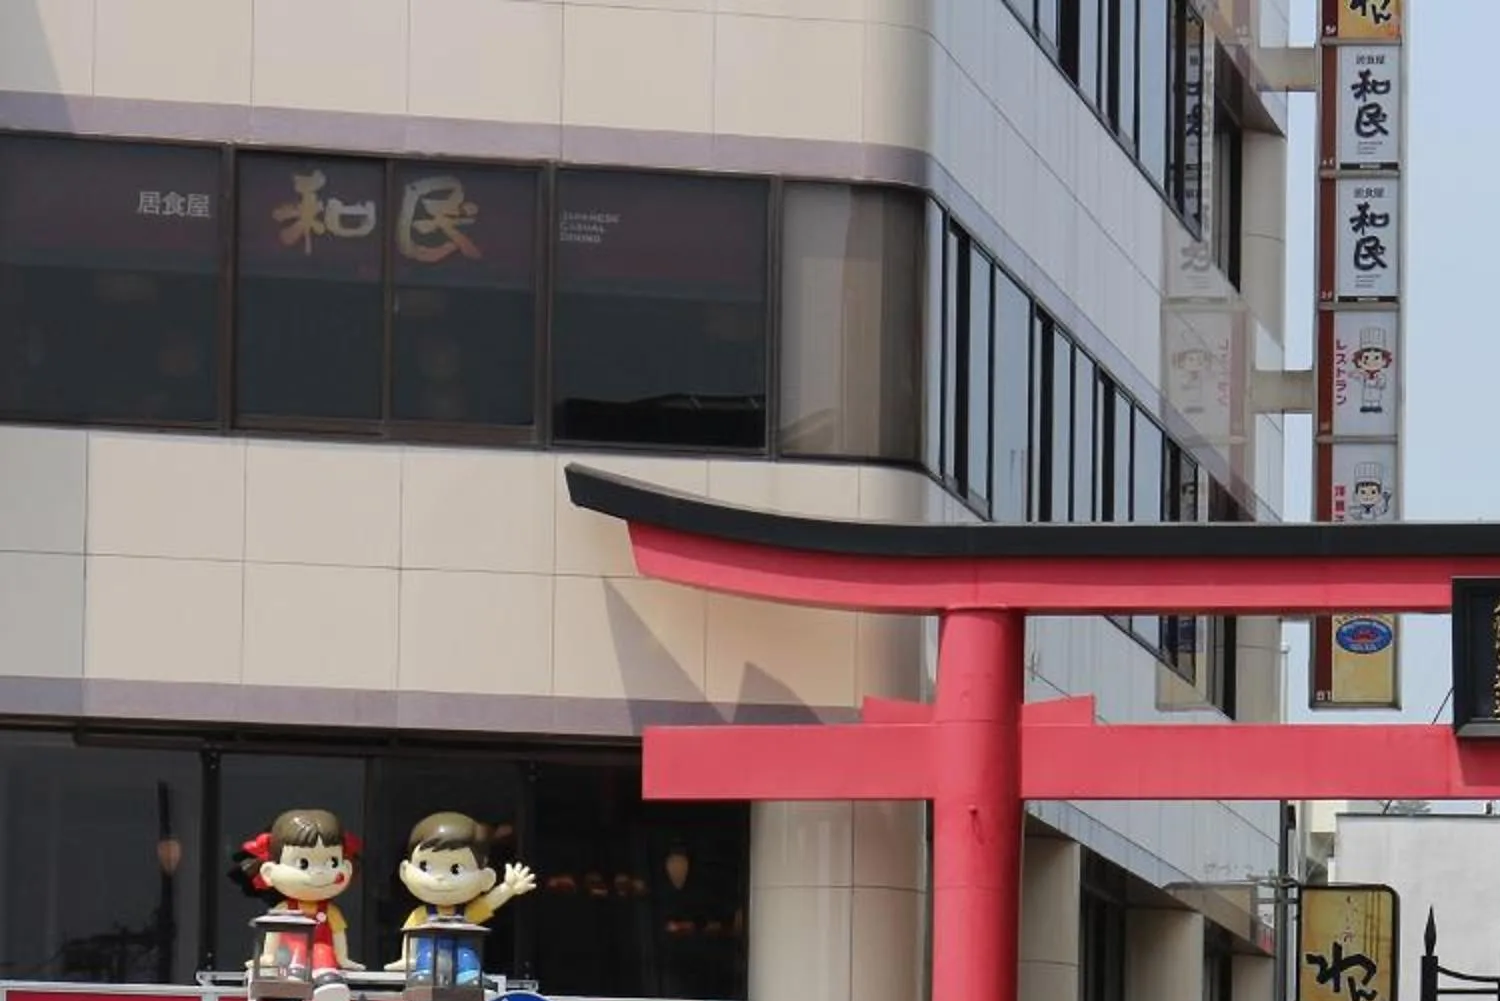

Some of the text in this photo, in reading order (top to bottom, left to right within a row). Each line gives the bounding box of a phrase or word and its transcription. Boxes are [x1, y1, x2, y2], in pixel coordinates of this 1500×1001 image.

[1351, 69, 1391, 138] 和民
[137, 190, 210, 218] 居食屋
[273, 169, 482, 262] 和民
[1350, 202, 1390, 271] 和民
[1335, 339, 1347, 406] レストラン
